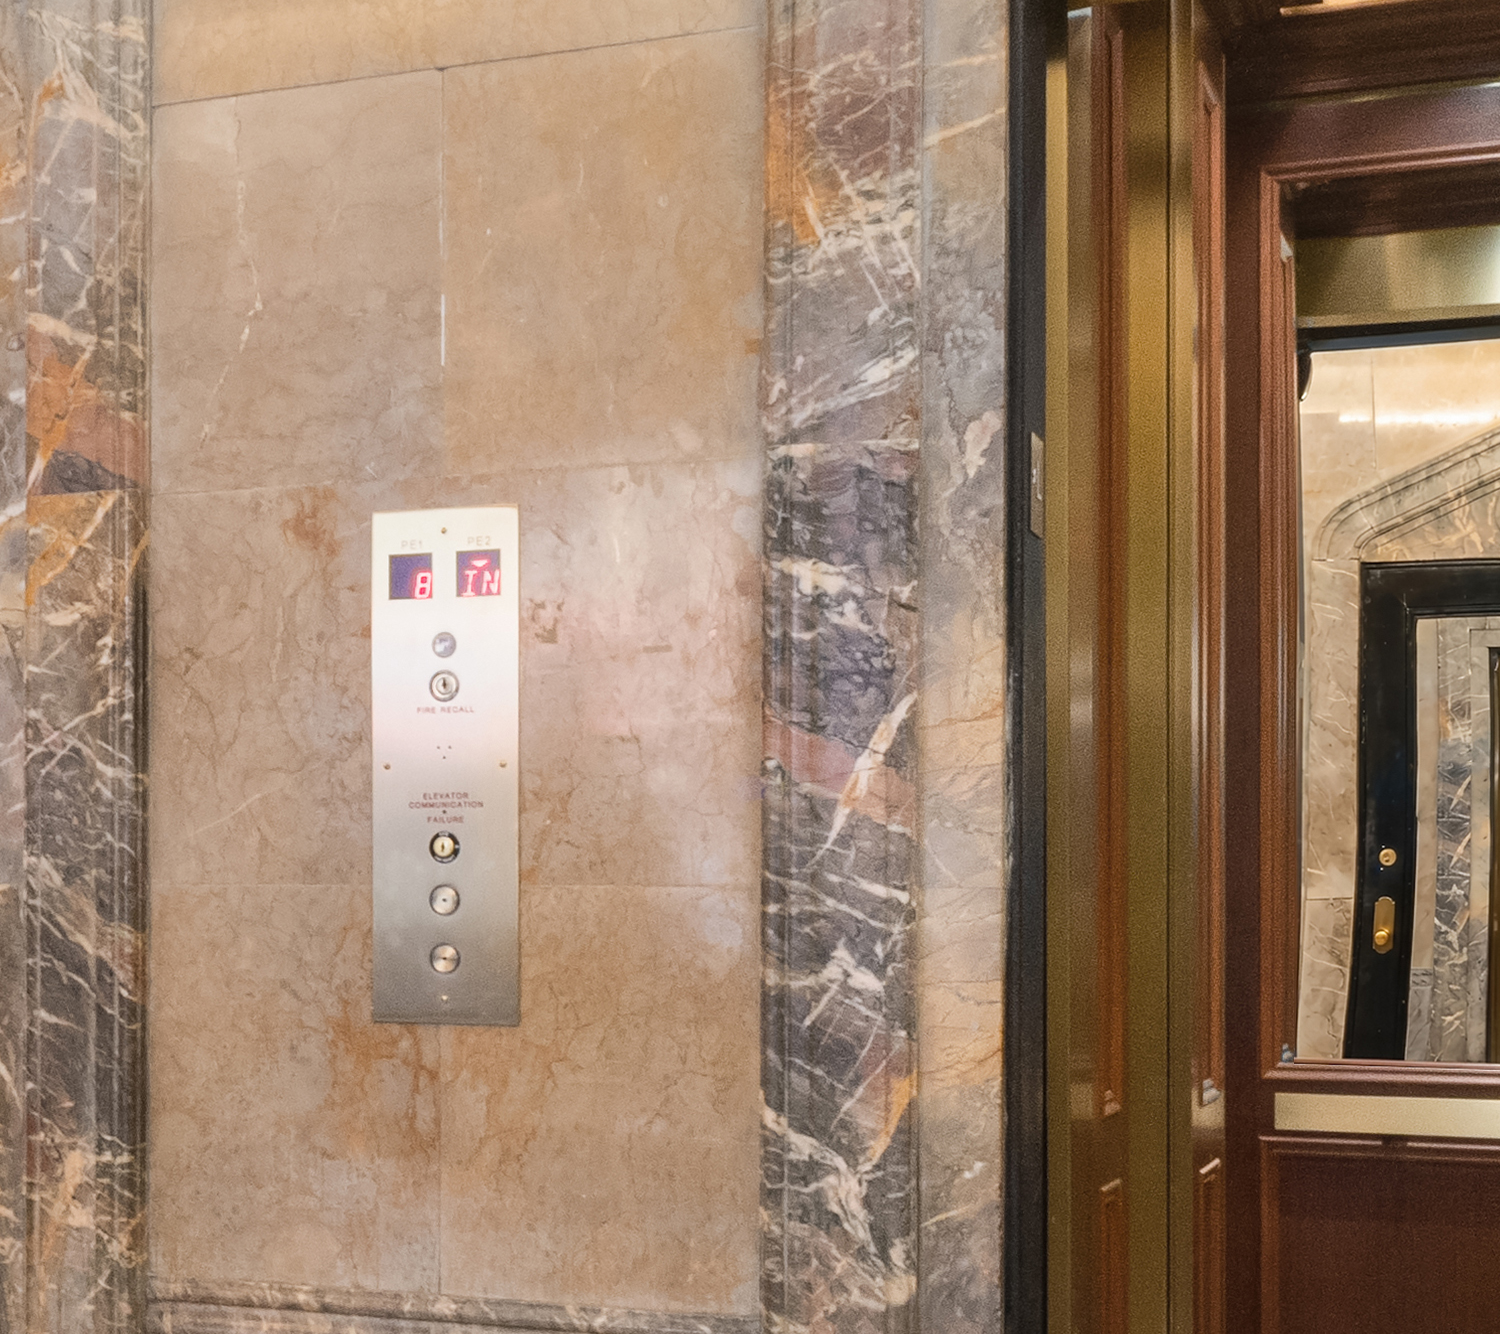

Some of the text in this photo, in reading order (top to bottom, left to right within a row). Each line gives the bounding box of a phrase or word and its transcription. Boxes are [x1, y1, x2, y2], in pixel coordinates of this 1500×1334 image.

[401, 539, 424, 550] PE1
[467, 535, 491, 547] PE2
[414, 571, 432, 599] 8
[461, 568, 501, 597] IN
[416, 706, 475, 714] FIRE RECALL
[422, 792, 469, 800] ELEVATOR
[408, 801, 484, 809] COMMUNICATION
[427, 816, 464, 824] FAILURE
